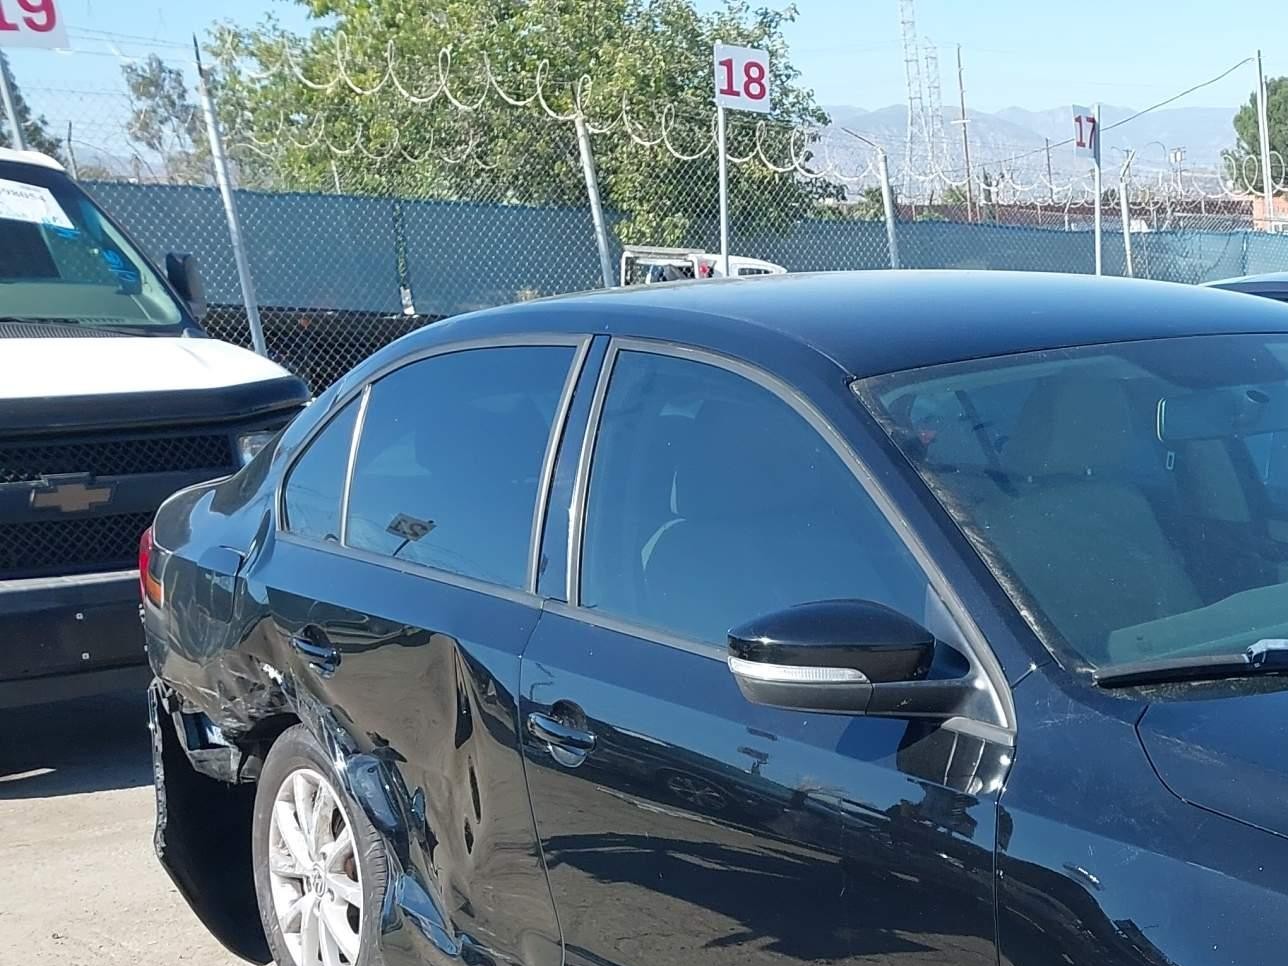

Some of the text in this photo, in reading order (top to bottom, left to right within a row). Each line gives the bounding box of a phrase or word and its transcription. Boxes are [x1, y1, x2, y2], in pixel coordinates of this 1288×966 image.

[0, 0, 56, 32] 9
[718, 58, 766, 100] 18
[1074, 115, 1097, 150] 17
